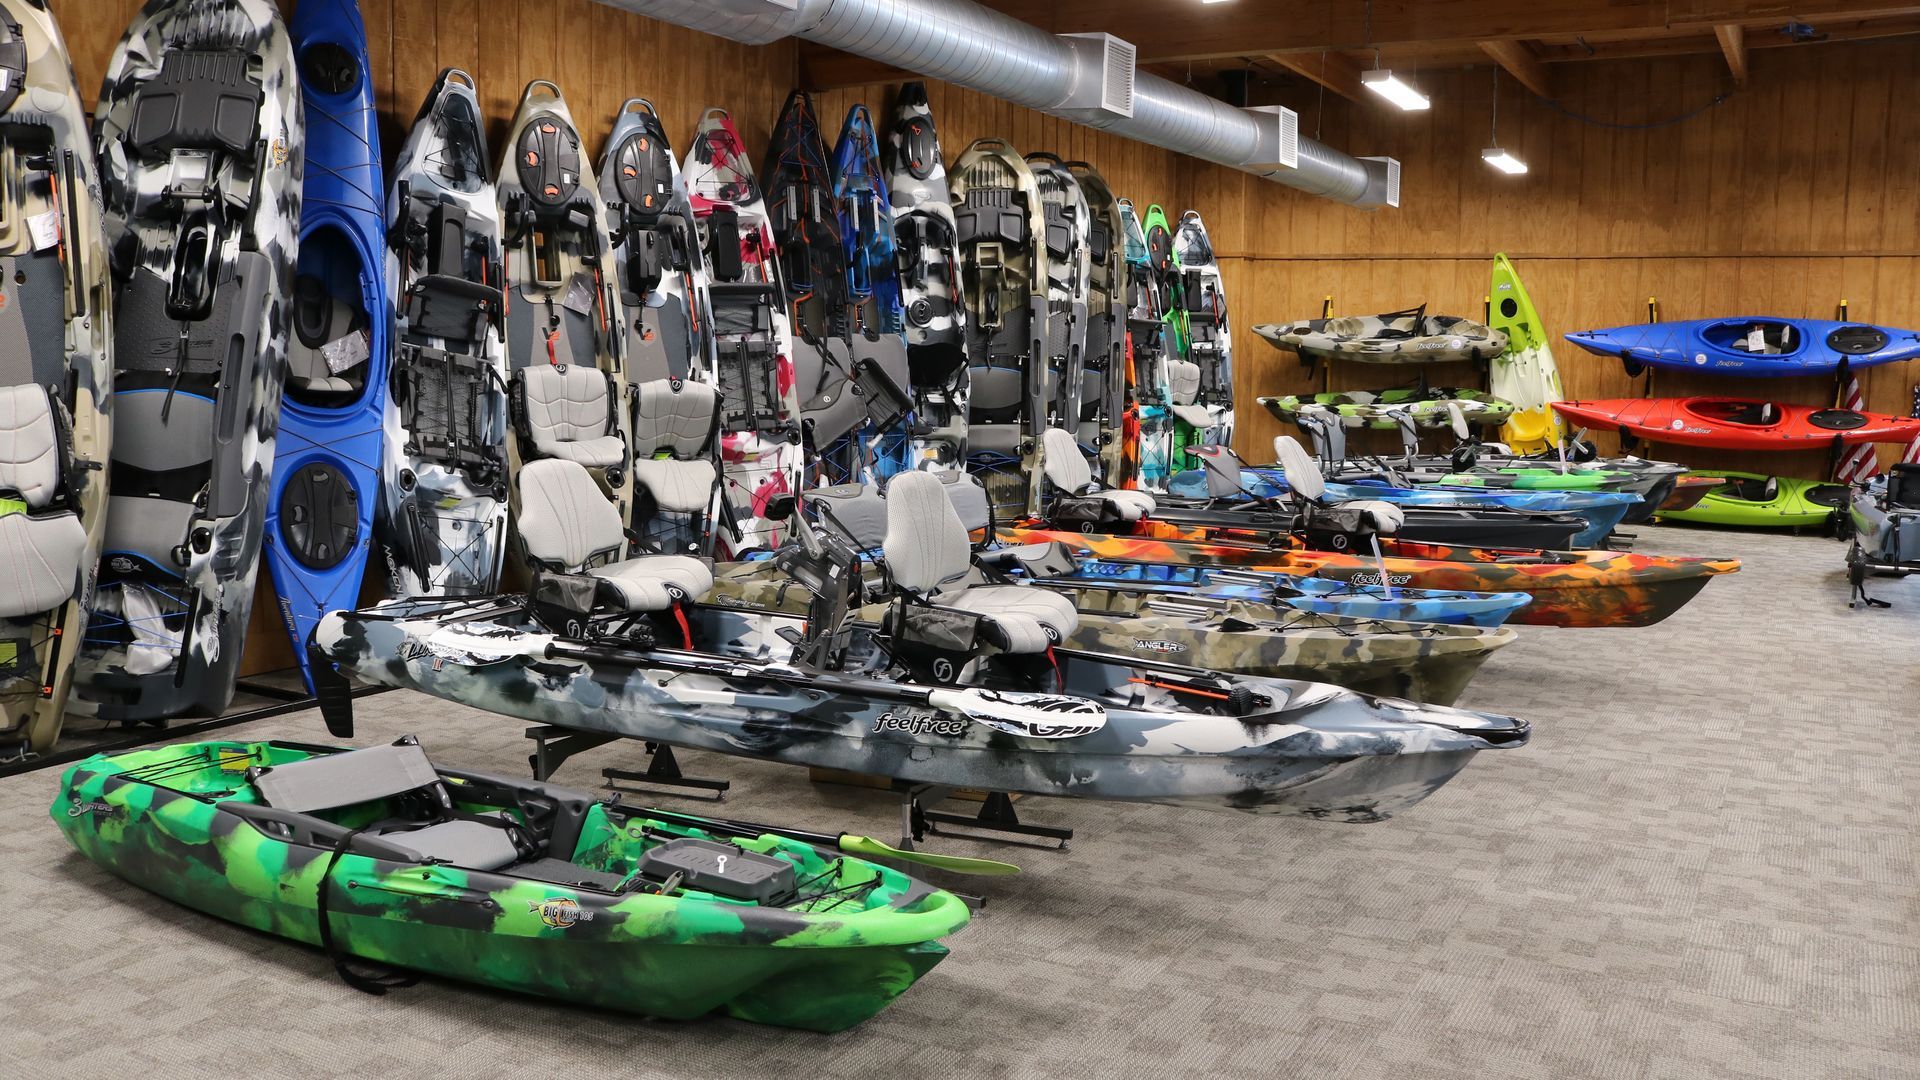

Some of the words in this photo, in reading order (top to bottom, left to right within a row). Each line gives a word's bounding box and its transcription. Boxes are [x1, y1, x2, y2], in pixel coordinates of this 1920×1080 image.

[382, 543, 403, 593] MOKEN
[1136, 640, 1180, 652] ANGLER
[872, 712, 967, 736] feelfree
[543, 905, 558, 918] BIG
